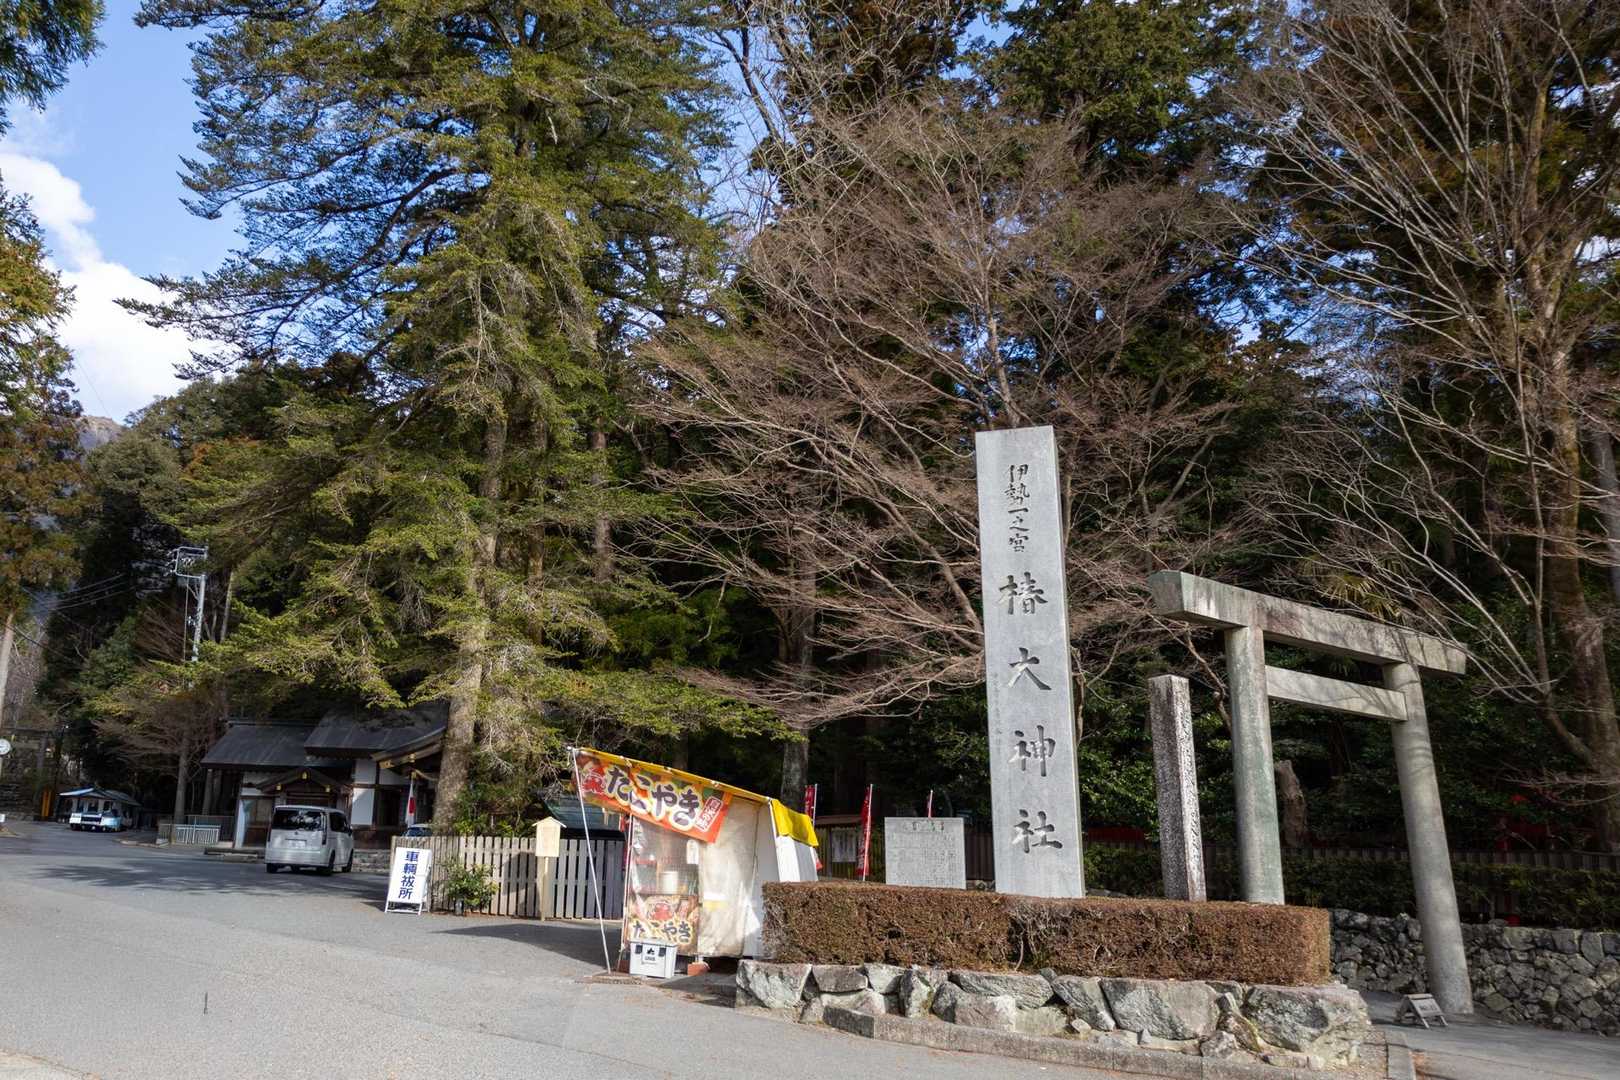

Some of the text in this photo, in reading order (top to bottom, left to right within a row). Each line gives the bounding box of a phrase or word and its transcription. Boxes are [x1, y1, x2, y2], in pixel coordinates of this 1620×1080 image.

[607, 766, 700, 826] たこやき
[998, 571, 1063, 854] 椿大神社
